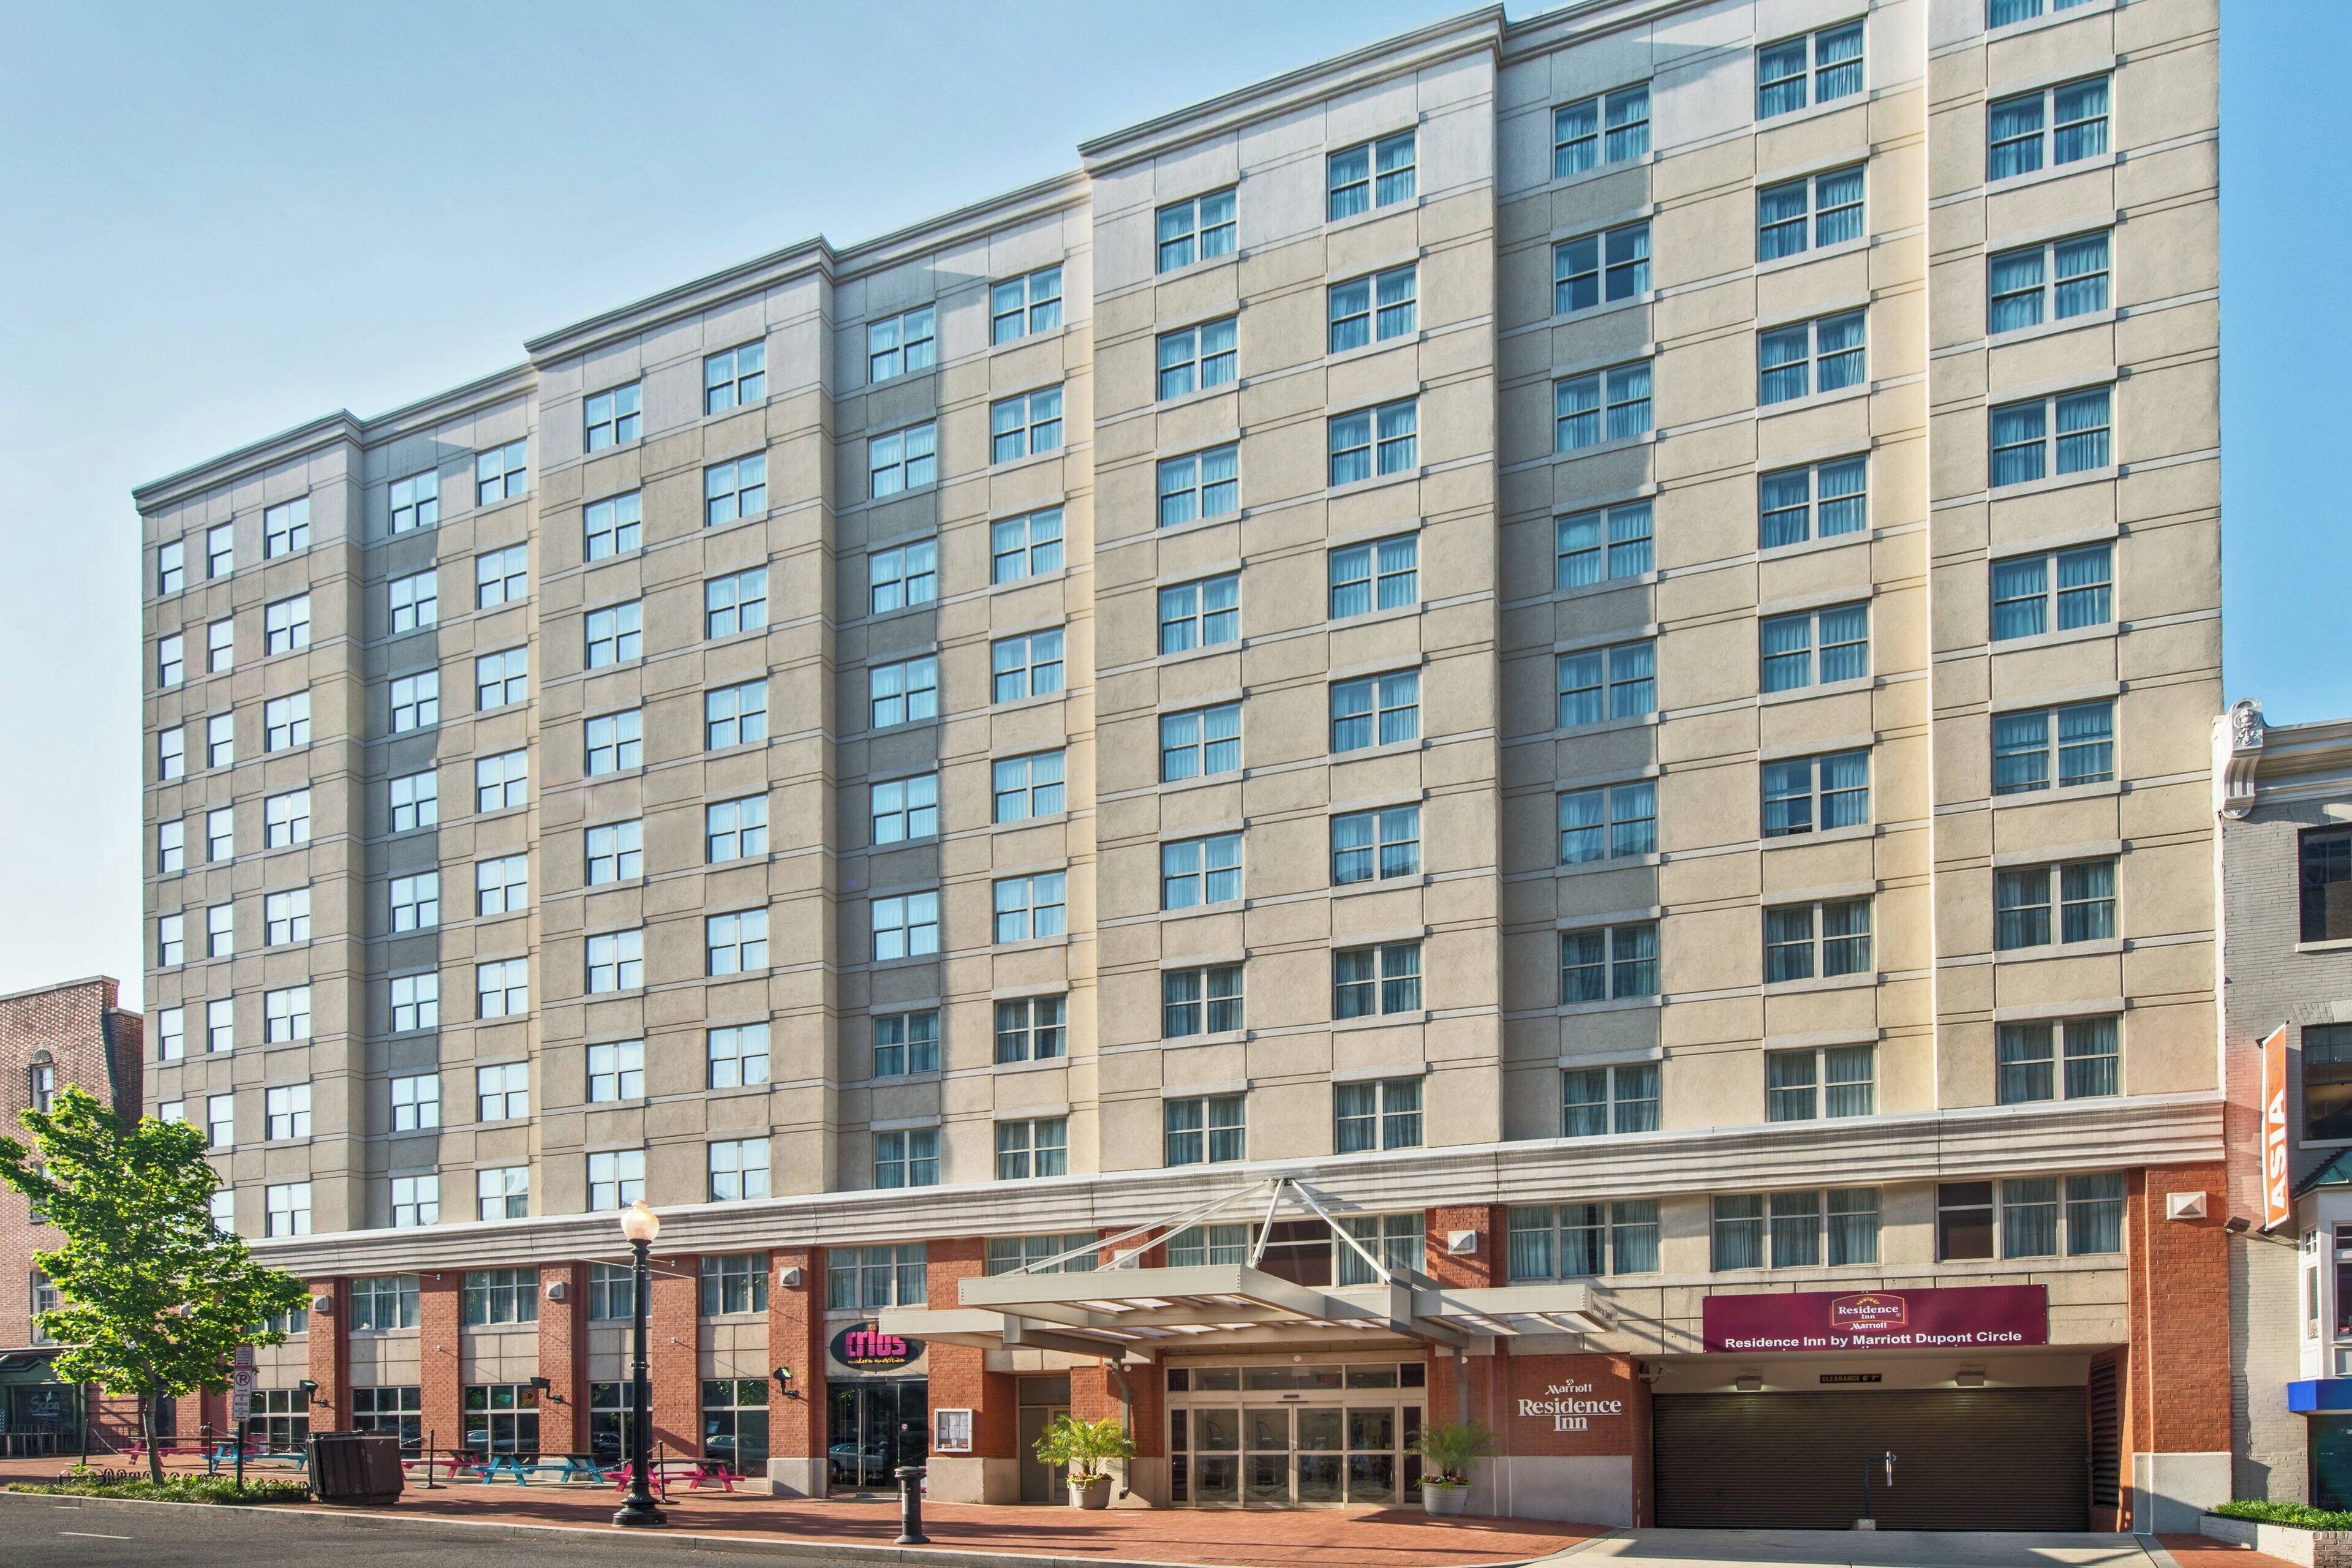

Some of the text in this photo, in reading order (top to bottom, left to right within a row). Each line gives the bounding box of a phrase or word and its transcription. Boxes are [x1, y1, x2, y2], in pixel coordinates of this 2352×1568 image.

[2268, 1088, 2286, 1209] ASIA
[1838, 1306, 1899, 1314] Residence
[1725, 1332, 2022, 1348] Residence Inn by Marriott Dupont Circle
[1545, 1383, 1593, 1395] Marriott
[1517, 1397, 1622, 1417] Residence
[1553, 1414, 1588, 1431] Inn
